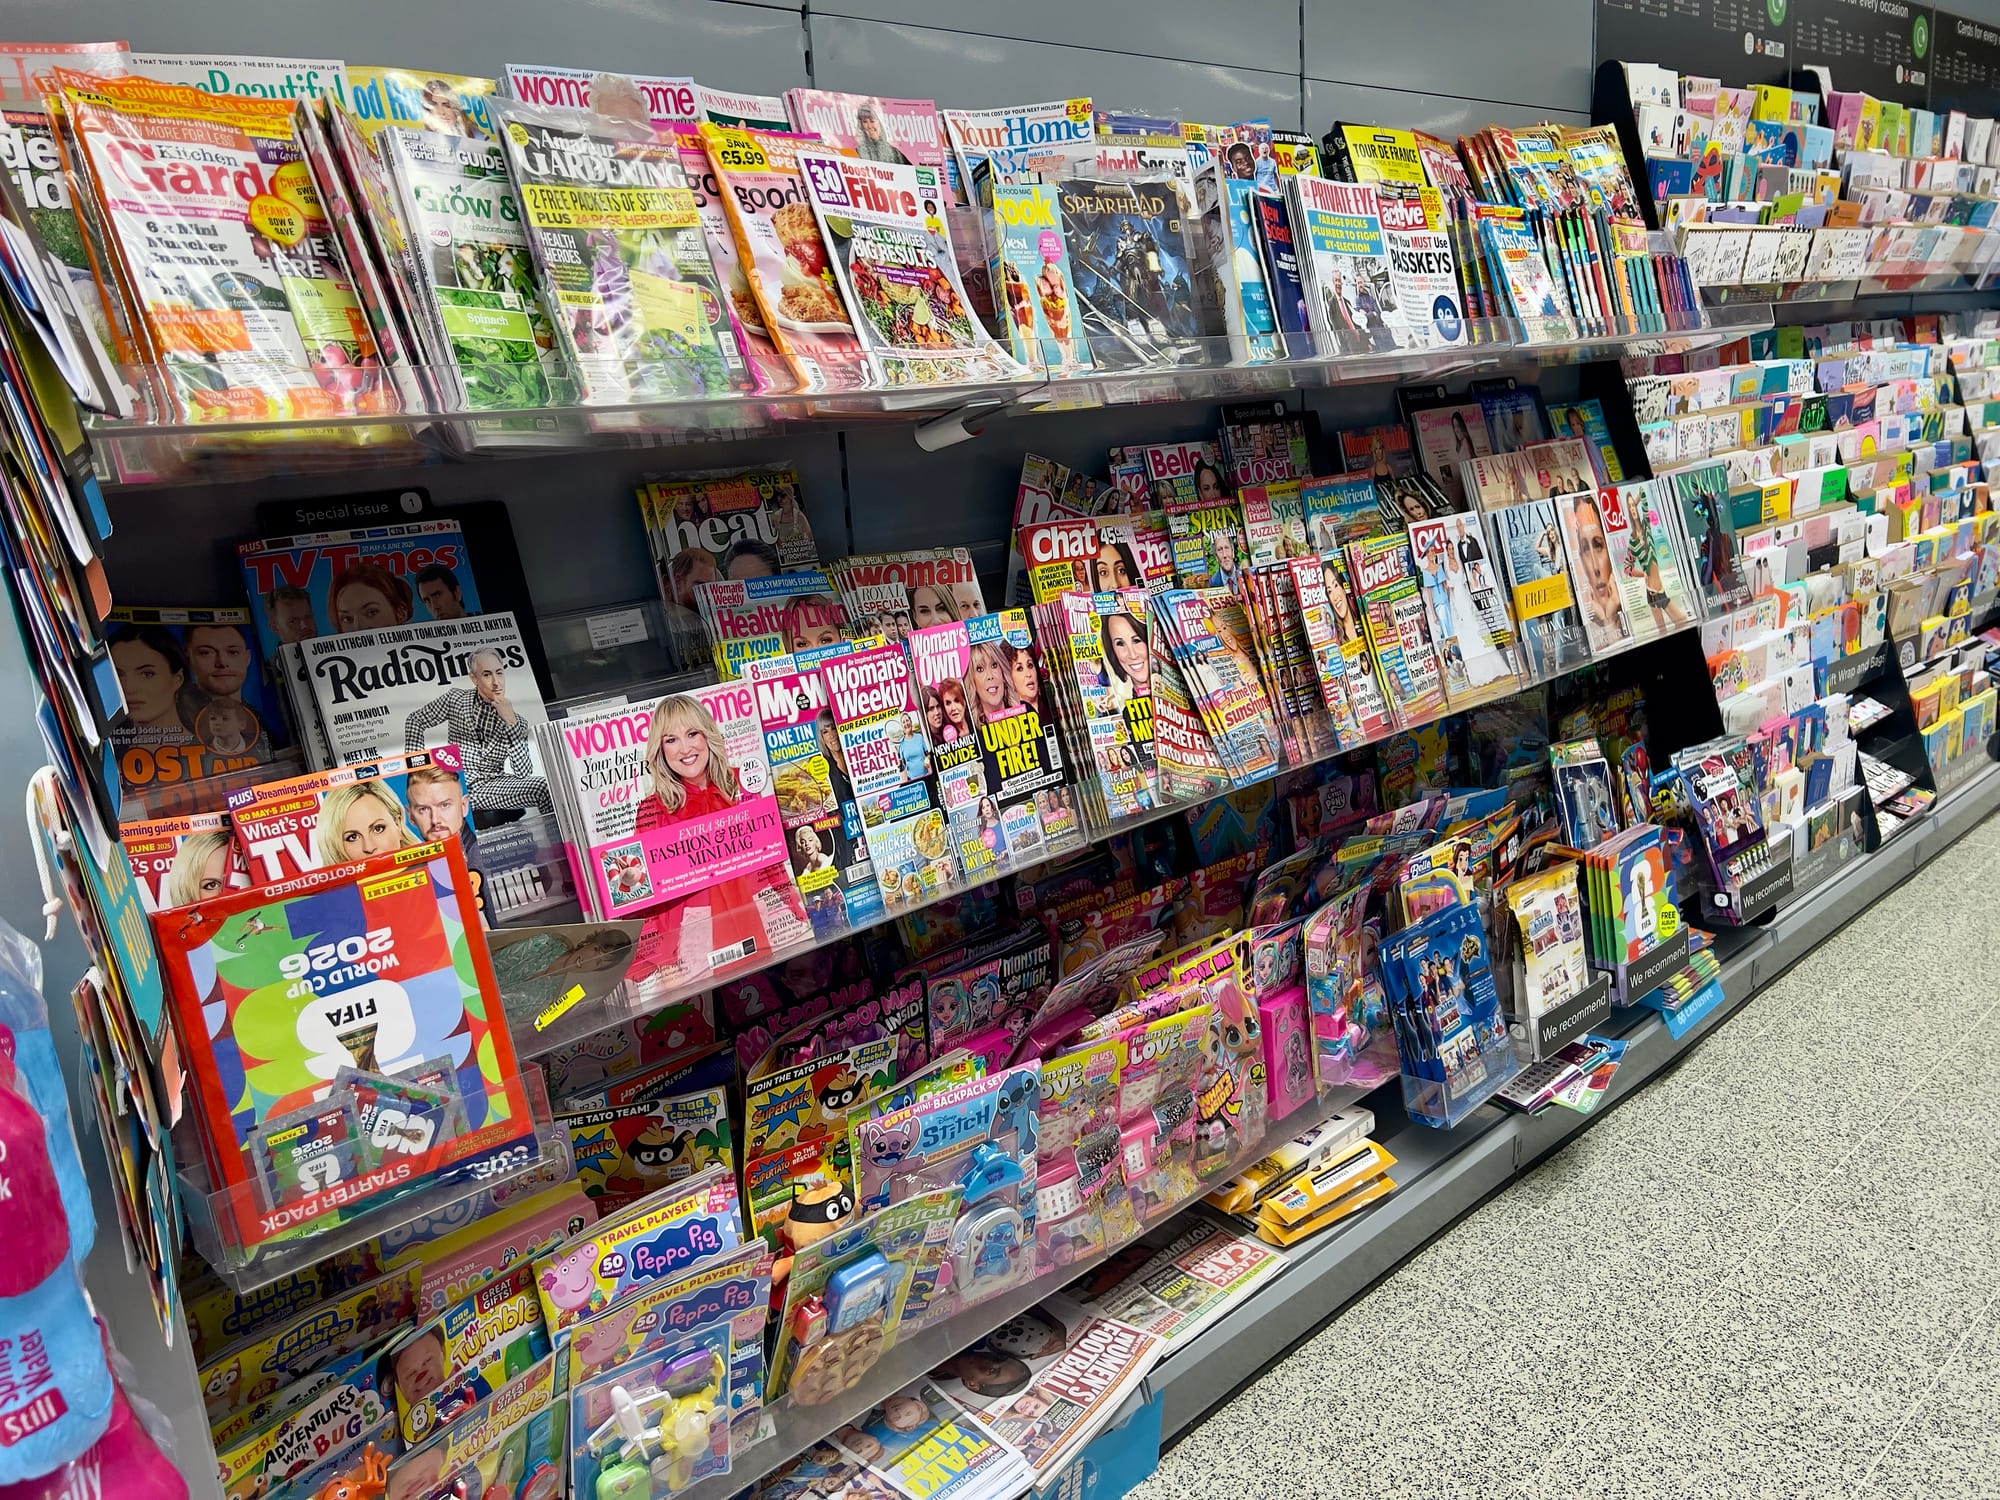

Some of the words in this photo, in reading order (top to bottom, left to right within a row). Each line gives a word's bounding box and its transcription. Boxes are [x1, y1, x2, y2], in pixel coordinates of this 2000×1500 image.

[1880, 2, 1908, 18] occasion
[1958, 20, 1973, 37] Cards
[1974, 25, 1982, 39] for
[1983, 28, 1998, 45] every
[1041, 104, 1064, 112] HOLIDAY!
[1065, 103, 1093, 116] £3.49
[156, 145, 240, 167] Kitchen
[726, 138, 752, 150] SAVE
[1353, 143, 1378, 158] TOUR
[1380, 147, 1389, 160] DE
[1390, 147, 1418, 163] FRANCE
[457, 151, 506, 170] GUIDE
[721, 150, 765, 166] £5.99
[810, 165, 842, 192] 30
[841, 162, 870, 178] Boost
[871, 167, 894, 182] Your
[258, 204, 290, 216] BEANS
[530, 190, 537, 209] 2
[542, 190, 570, 210] FREE
[573, 191, 620, 212] PACKETS
[621, 194, 633, 212] OF
[640, 194, 673, 213] SEEDS
[846, 177, 917, 218] Fibre
[1064, 192, 1165, 218] SPEARHEAD
[1311, 180, 1353, 213] PRIVATE
[1352, 187, 1376, 215] EYE
[537, 213, 571, 224] PLUS
[625, 214, 657, 225] HERB
[661, 215, 698, 225] GUIDE
[1260, 202, 1279, 222] New
[541, 232, 576, 249] HEALTH
[851, 224, 882, 242] SMALL
[882, 228, 926, 249] CHANGES
[545, 248, 581, 265] HEROES
[852, 238, 880, 259] BIG
[880, 242, 937, 268] RESULTS
[1391, 249, 1451, 274] PASSKEYS
[467, 312, 509, 328] Spinach
[1677, 467, 1728, 500] VOGUE
[296, 507, 349, 523] Special
[351, 501, 389, 516] issue
[1601, 498, 1627, 532] Red
[665, 498, 778, 559] heat
[1250, 525, 1283, 537] PUZZLES
[1416, 523, 1446, 546] OK!
[1032, 522, 1097, 563] Chat
[747, 580, 763, 591] YOUR
[765, 578, 797, 589] SYMPTOMS
[798, 576, 828, 586] EXPLAINED
[853, 559, 973, 589] woman
[1041, 582, 1046, 590] A
[1047, 577, 1073, 590] MONSTER
[1293, 566, 1318, 586] Take
[864, 599, 908, 612] SPECIAL
[1302, 586, 1328, 607] Break
[312, 641, 335, 656] JOHN
[337, 635, 374, 651] LITHGOW
[380, 630, 413, 643] ELEANOR
[414, 624, 457, 639] TOMLINSON
[462, 621, 483, 634] ADEEL
[484, 617, 513, 630] AKHTAR
[911, 628, 968, 658] Woman's
[969, 626, 1000, 642] SKINCARE
[726, 642, 748, 659] EAT
[750, 637, 780, 655] YOUR
[1075, 646, 1102, 659] SPECIAL
[751, 663, 761, 680] 8
[760, 661, 775, 669] EASY
[776, 658, 793, 667] MOVES
[825, 652, 906, 694] Woman's
[1828, 673, 1837, 685] ift
[1838, 666, 1856, 682] Wrap
[1857, 661, 1869, 672] and
[1870, 654, 1886, 668] Bags
[835, 681, 908, 720] Weekly
[333, 713, 353, 725] JOHN
[354, 706, 390, 719] TRAVOLTA
[839, 723, 854, 733] OUR
[855, 719, 870, 729] EASY
[872, 714, 886, 725] PLAN
[886, 710, 899, 719] FOR
[767, 730, 793, 748] ONE
[795, 724, 814, 740] TIN
[844, 727, 884, 747] Better
[982, 712, 1043, 752] UNDER
[583, 758, 612, 774] Your
[615, 749, 638, 766] best
[769, 742, 817, 762] WONDERS!
[846, 738, 890, 763] HEART
[941, 748, 977, 770] DIVIDE
[996, 741, 1040, 779] FIRE!
[580, 760, 652, 791] SUMMER
[851, 752, 899, 778] HEALTH
[228, 789, 253, 808] PLUS!
[257, 785, 296, 801] Streaming
[298, 780, 319, 794] guide
[330, 773, 353, 784] NETFLIX
[242, 816, 296, 841] What's
[1006, 816, 1036, 832] HOLIDAYS
[650, 833, 712, 864] FASHION
[715, 829, 726, 844] &
[729, 812, 776, 841] BEAUTY
[687, 849, 725, 868] MINI
[727, 837, 753, 859] MAG
[1410, 860, 1432, 877] Belle
[1743, 895, 1754, 908] We
[1755, 873, 1790, 902] recommend
[1661, 911, 1675, 919] FREE
[279, 926, 395, 976] 2026
[1002, 945, 1050, 978] MONSTER
[326, 955, 401, 985] WORLD
[1021, 968, 1047, 988] HIGH
[1630, 973, 1643, 988] We
[1644, 944, 1687, 983] recommend
[286, 978, 325, 999] CUP
[324, 996, 379, 1029] FIFA
[1542, 1026, 1558, 1042] We
[1559, 993, 1606, 1028] recommend
[1130, 1033, 1180, 1064] LOVE
[752, 1080, 772, 1094] JOIN
[773, 1073, 791, 1087] THE
[792, 1064, 816, 1080] TATO
[818, 1053, 843, 1070] TEAM!
[752, 1090, 812, 1123] SUPERTATO
[884, 1110, 912, 1128] CUTE
[913, 1085, 987, 1115] MINI-BACKPACK
[987, 1074, 1003, 1090] SET
[319, 1162, 412, 1214] STARTER
[260, 1191, 319, 1236] PACK
[688, 1225, 718, 1249] Pig
[635, 1246, 690, 1274] Peppa
[1191, 1242, 1252, 1280] CAR
[1217, 1249, 1266, 1287] CLASSIC
[482, 1279, 511, 1300] GREAT
[452, 1298, 540, 1366] Tumble
[464, 1319, 480, 1341] Mr
[22, 1328, 55, 1396] Water
[1040, 1319, 1117, 1390] FOOTBALL
[1068, 1333, 1136, 1403] WOMEN'S
[2, 1391, 57, 1445] Still
[264, 1386, 355, 1473] ADVENTURES
[314, 1401, 378, 1457] BUGS
